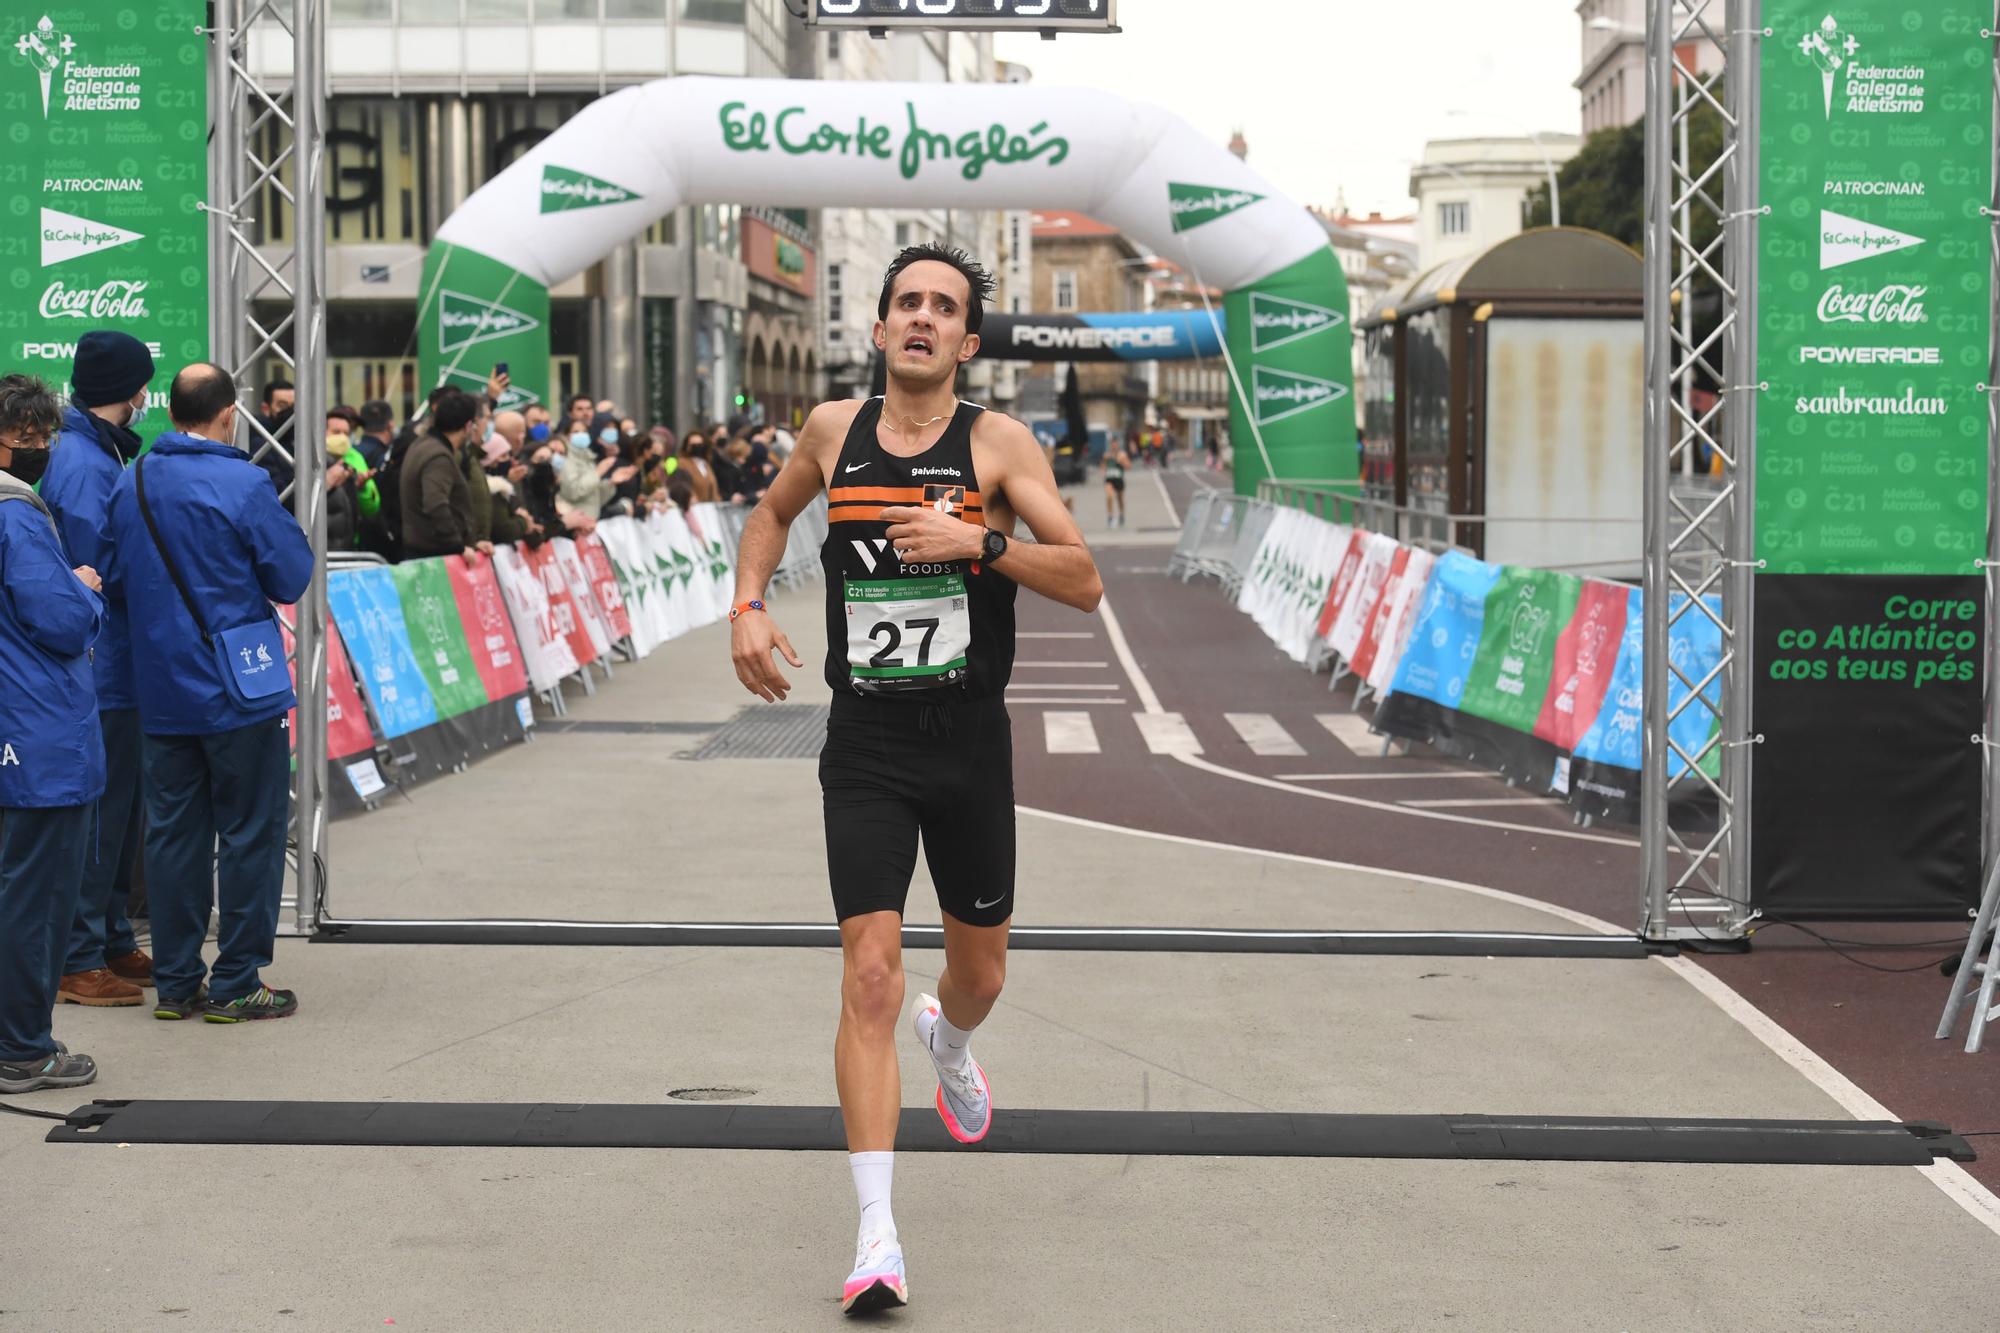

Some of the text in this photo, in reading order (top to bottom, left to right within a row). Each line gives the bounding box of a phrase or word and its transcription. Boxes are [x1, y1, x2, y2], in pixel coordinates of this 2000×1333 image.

[64, 61, 140, 78] Federación
[1846, 62, 1925, 79] Federación
[64, 80, 140, 99] Galega de
[1846, 80, 1925, 100] Galega de
[65, 95, 140, 111] Atletismo
[1846, 97, 1924, 113] Atletismo
[720, 101, 1070, 180] El Corte Inglés
[43, 179, 143, 192] PATROCINAN:
[1823, 181, 1925, 195] PATROCINAN:
[44, 227, 120, 245] El Corte Inglés
[1823, 230, 1901, 249] El Corte Inglés
[39, 280, 148, 318] Coca-Cola
[1817, 284, 1927, 323] Coca-Cola
[1012, 325, 1175, 347] POWERADE
[1800, 346, 1941, 364] POWERADE
[1795, 386, 1948, 415] sanbrandan
[900, 564, 951, 575] FOODS
[1885, 595, 1977, 621] Corre
[868, 617, 939, 668] 27
[1777, 622, 1976, 650] co Atlántico
[1769, 653, 1975, 689] aos teus pés
